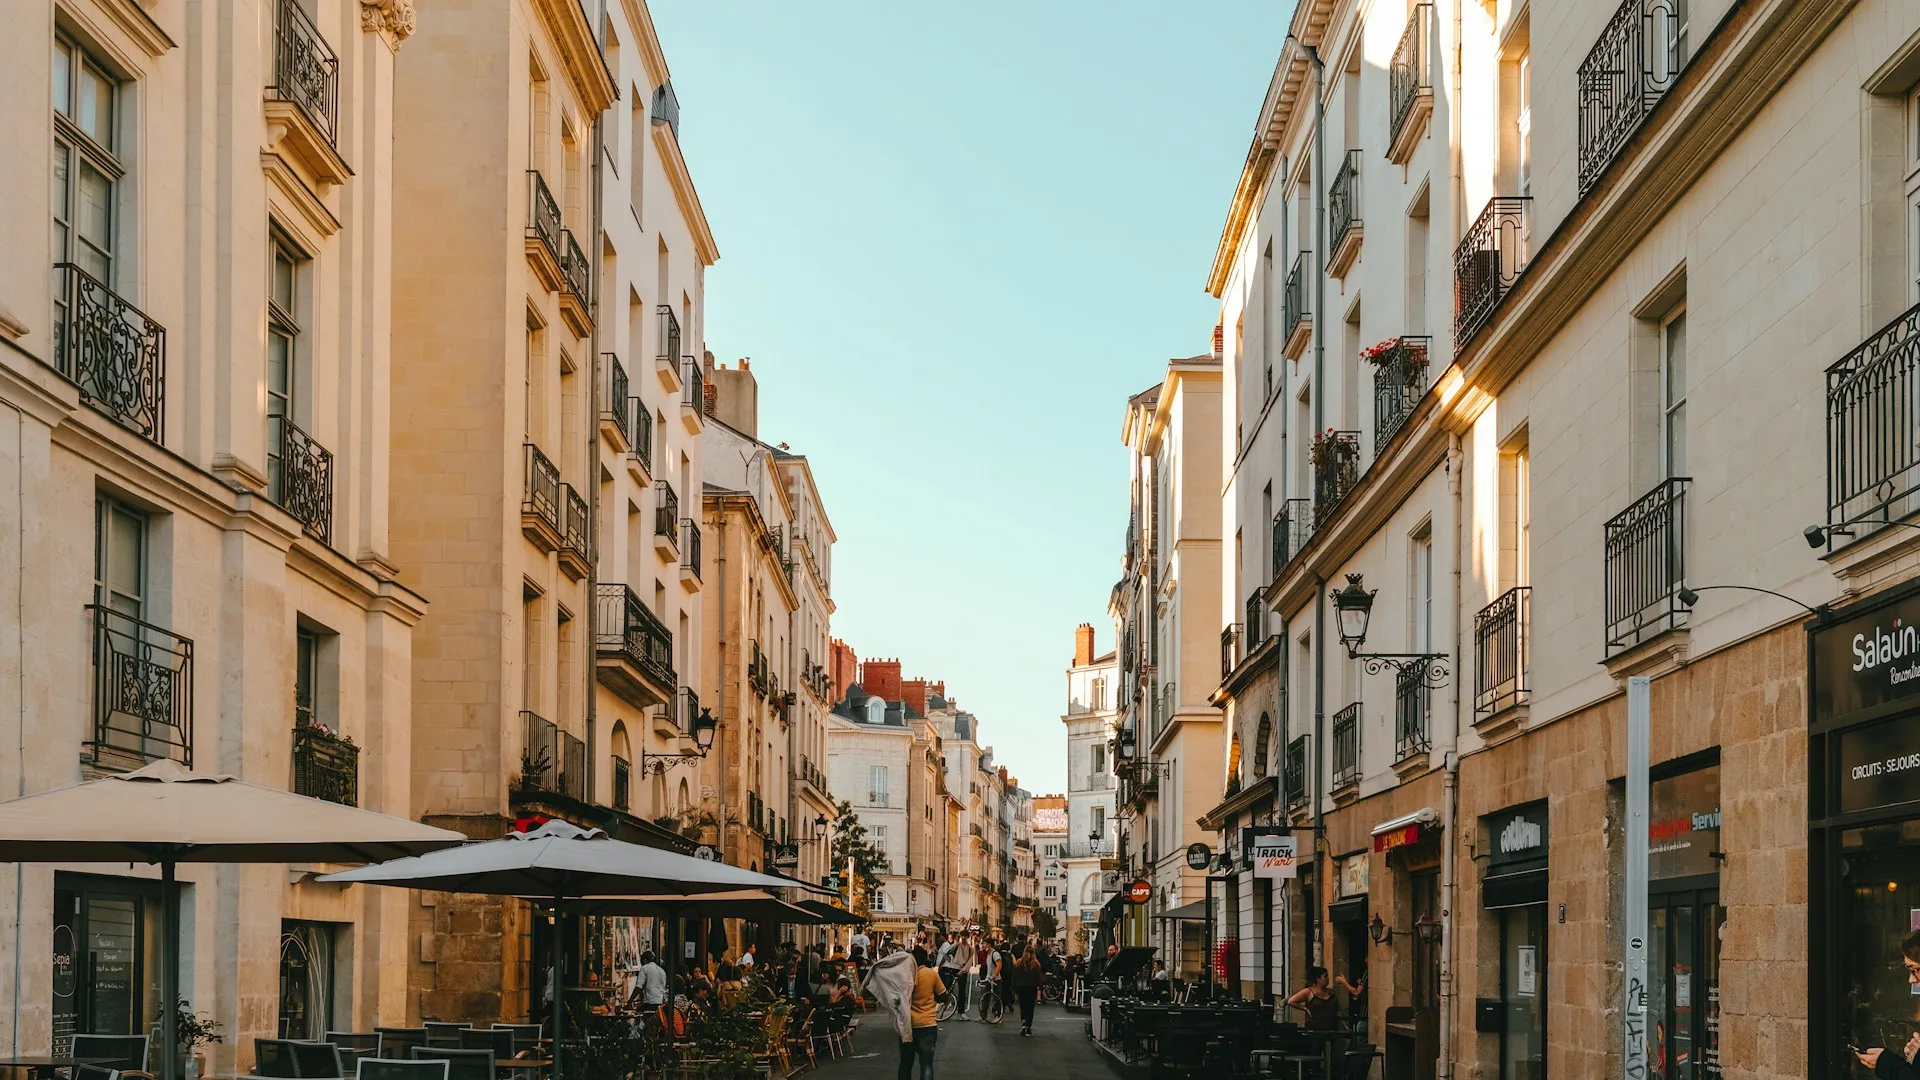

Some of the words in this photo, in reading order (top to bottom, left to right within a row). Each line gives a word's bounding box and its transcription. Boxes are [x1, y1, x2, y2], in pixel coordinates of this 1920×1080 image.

[1852, 761, 1882, 780] CIRCUITS
[1886, 753, 1920, 773] SEJOURS
[1256, 845, 1293, 858] TRACK
